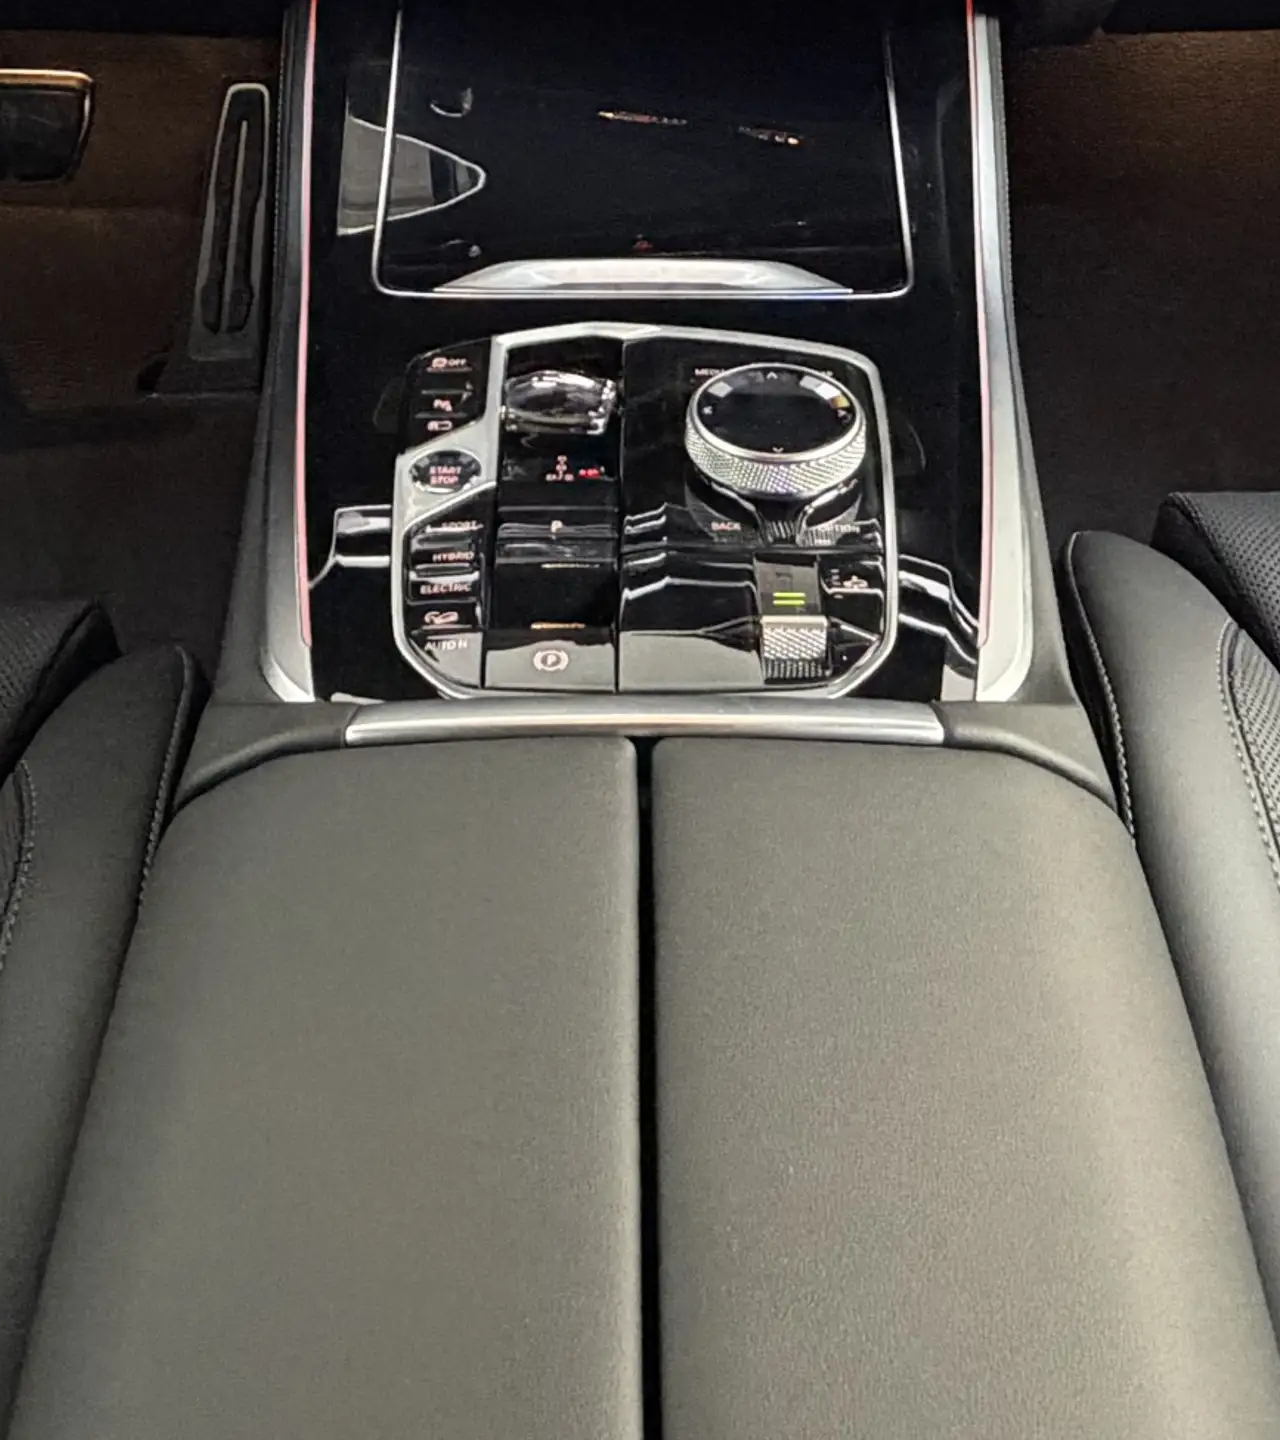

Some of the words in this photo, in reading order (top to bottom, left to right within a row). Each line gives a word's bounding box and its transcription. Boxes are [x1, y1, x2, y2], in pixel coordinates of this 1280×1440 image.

[447, 359, 468, 368] OFF
[428, 466, 463, 476] START
[429, 475, 459, 486] STOP
[711, 522, 742, 532] BACK
[420, 582, 472, 596] ELECTRIC
